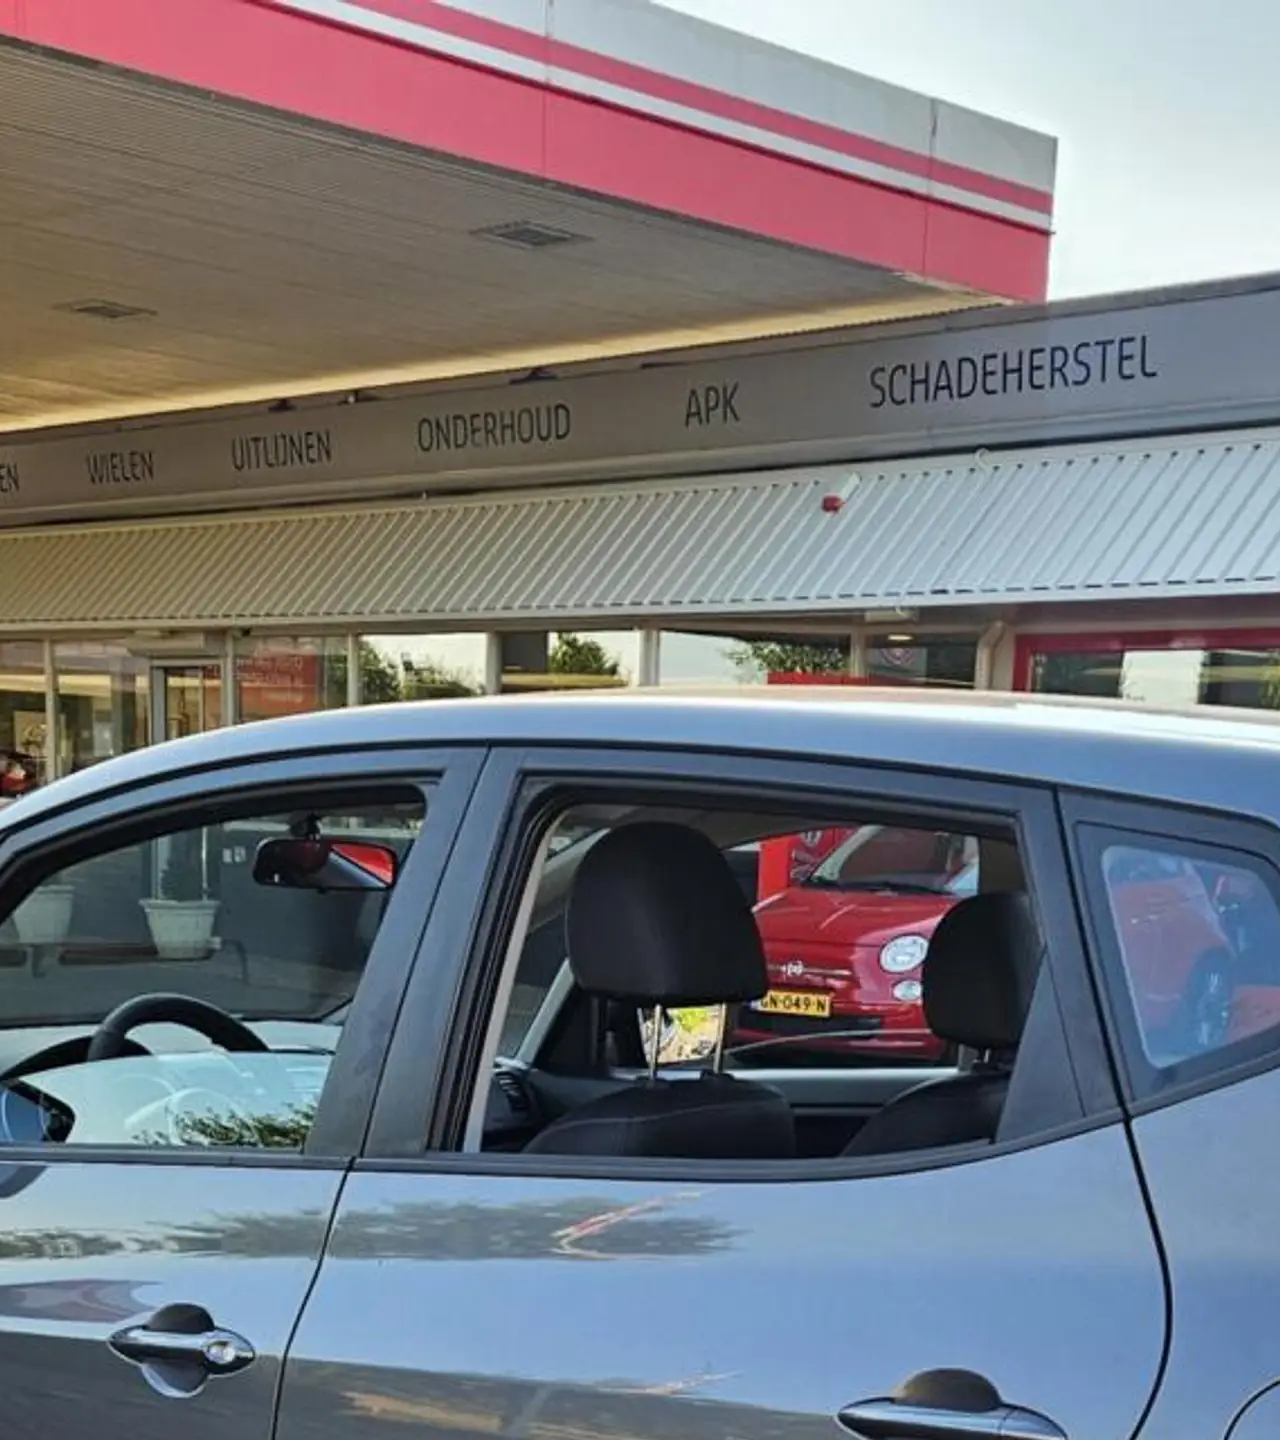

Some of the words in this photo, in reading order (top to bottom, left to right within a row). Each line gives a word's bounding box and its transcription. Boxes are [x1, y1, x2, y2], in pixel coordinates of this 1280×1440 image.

[869, 334, 1159, 409] SCHADEHERSTEL
[417, 402, 572, 452] ONDERHOUD
[684, 382, 740, 429] APK
[87, 450, 154, 485] WIELEN
[231, 430, 333, 471] UITLIJNEN
